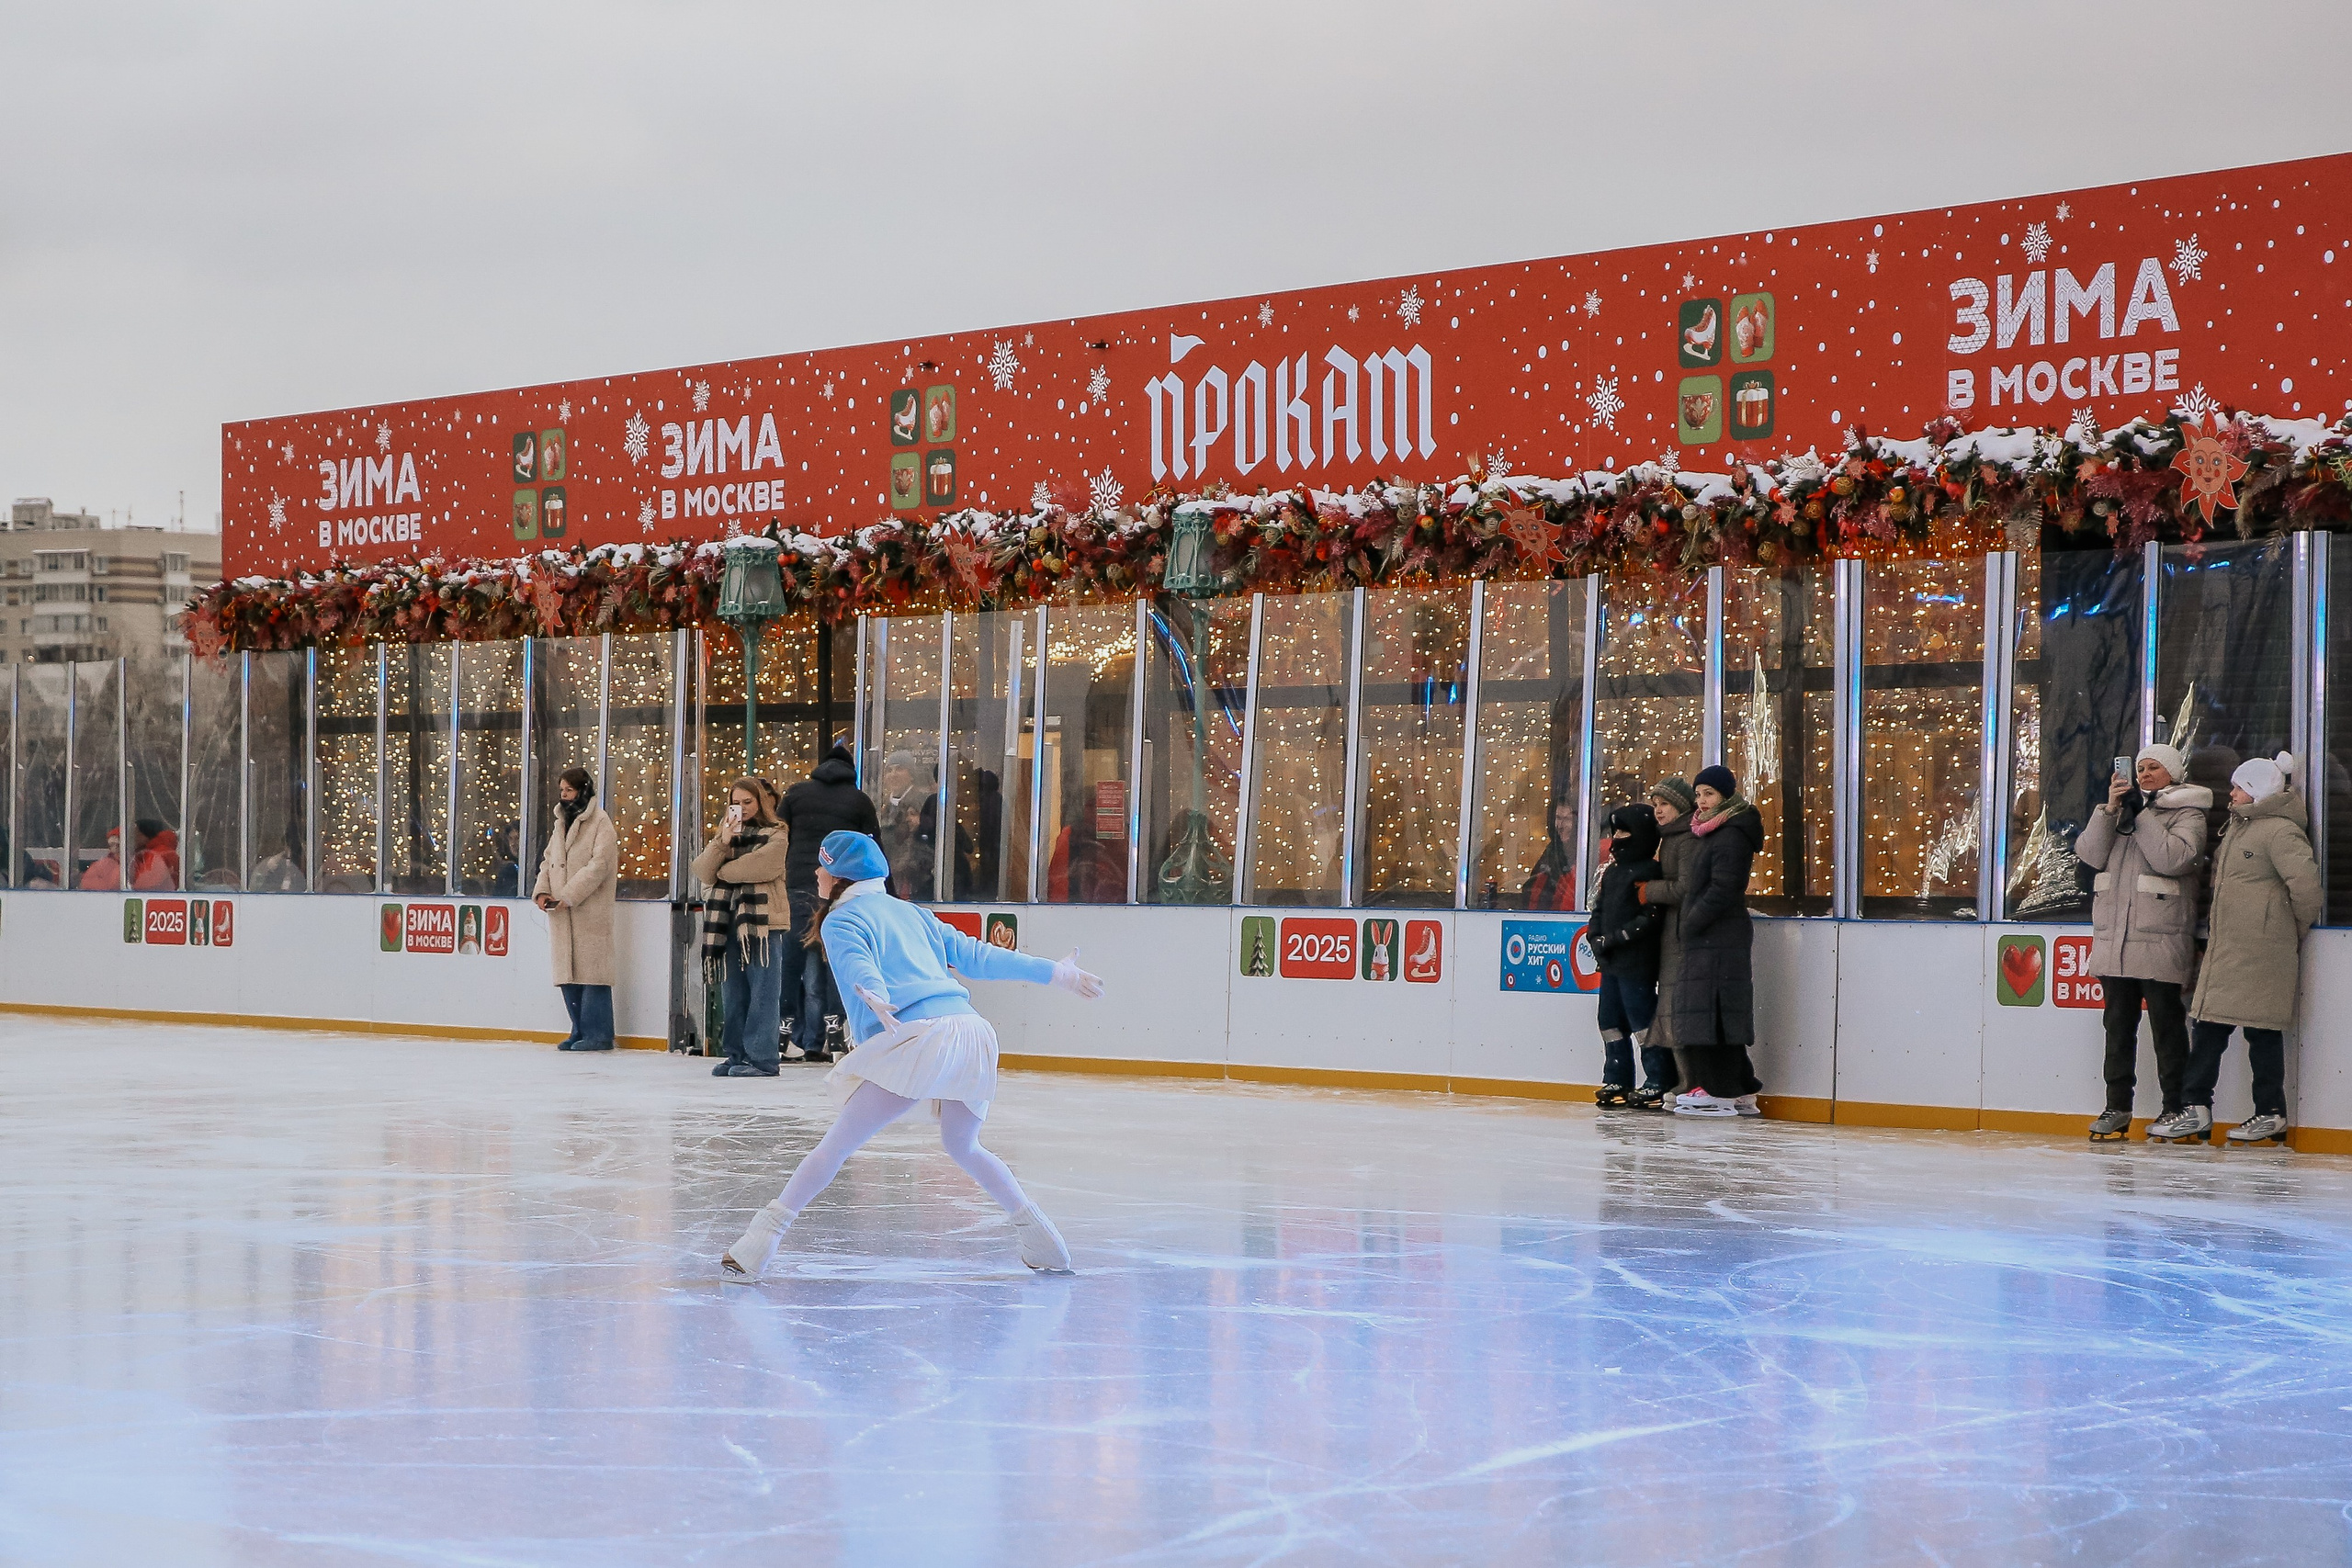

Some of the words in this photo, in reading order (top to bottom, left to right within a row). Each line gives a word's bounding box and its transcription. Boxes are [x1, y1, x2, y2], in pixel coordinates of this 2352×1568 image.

[1947, 256, 2181, 355] ЗИМА
[1948, 368, 1975, 410] В
[1990, 348, 2180, 406] МОСКВЕ
[661, 412, 785, 479] ЗИМА
[318, 452, 422, 511] ЗИМА
[662, 489, 677, 519] В
[684, 479, 786, 517] МОСКВЕ
[319, 520, 332, 547] В
[337, 513, 422, 547] МОСКВЕ
[149, 911, 184, 932] 2025
[409, 909, 452, 931] ЗИМА
[407, 935, 414, 947] В
[416, 935, 452, 948] МОСКВЕ
[1287, 933, 1351, 964] 2025
[1527, 942, 1566, 954] РУССКИЙ
[1527, 955, 1544, 966] ХИТ
[2057, 943, 2092, 977] ЗИ
[2057, 982, 2070, 1000] В
